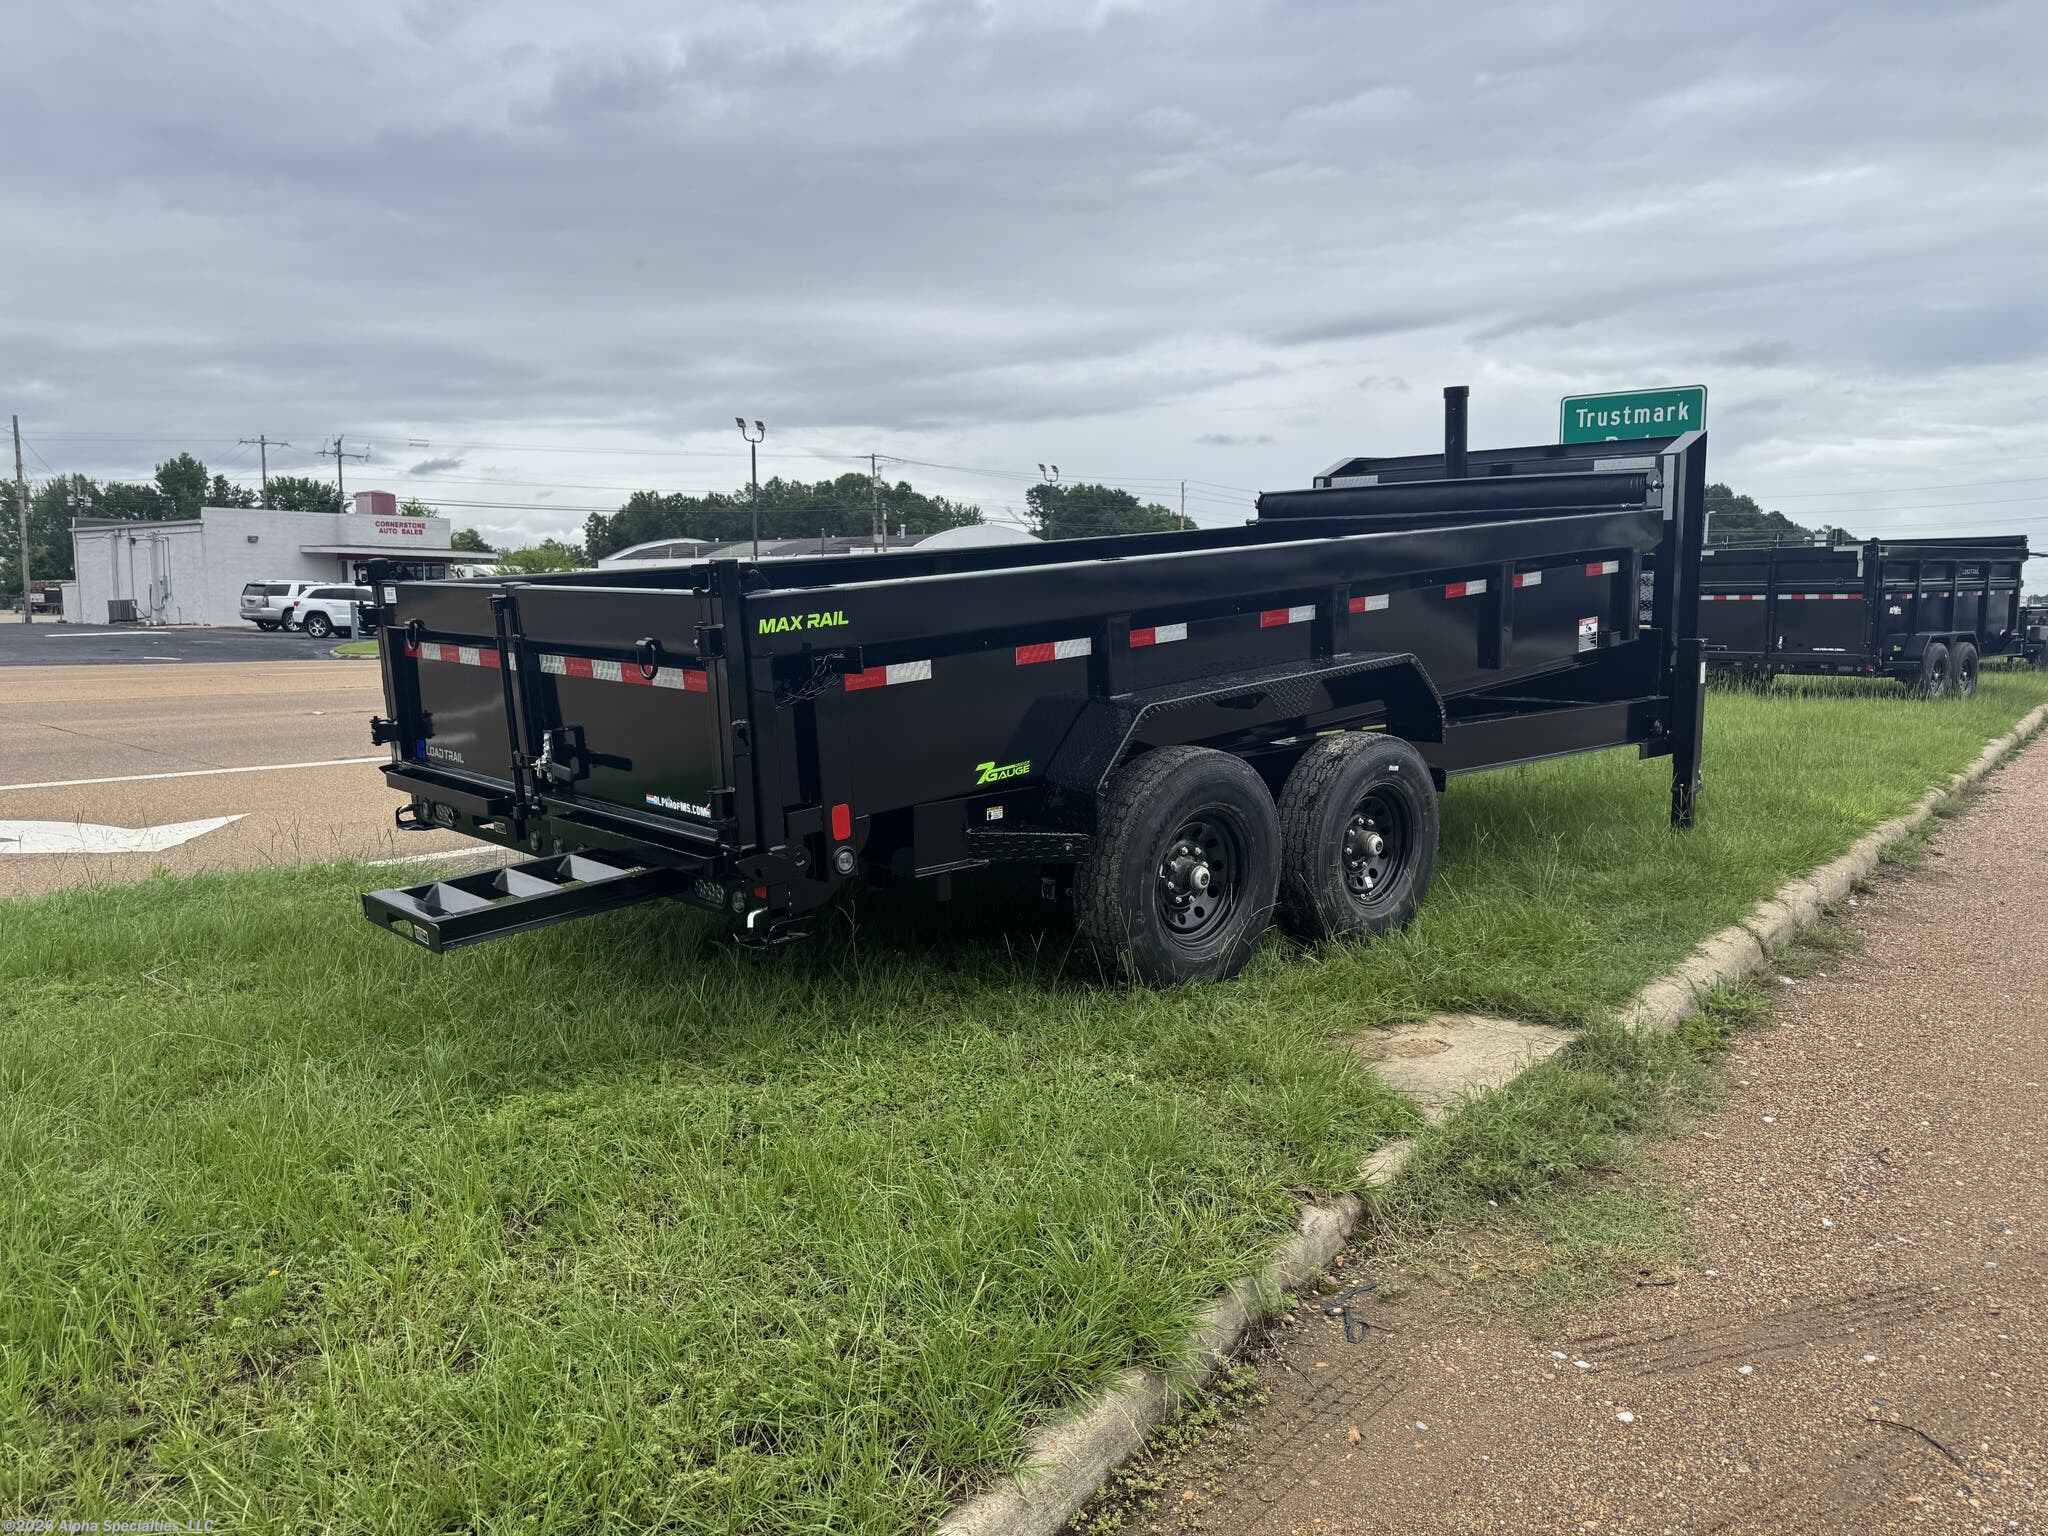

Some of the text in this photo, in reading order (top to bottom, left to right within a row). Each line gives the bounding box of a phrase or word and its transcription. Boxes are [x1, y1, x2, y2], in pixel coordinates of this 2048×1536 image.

[1576, 401, 1690, 428] Trustmark
[375, 521, 426, 529] CORNERSTONE
[758, 610, 850, 635] MAX RAIL
